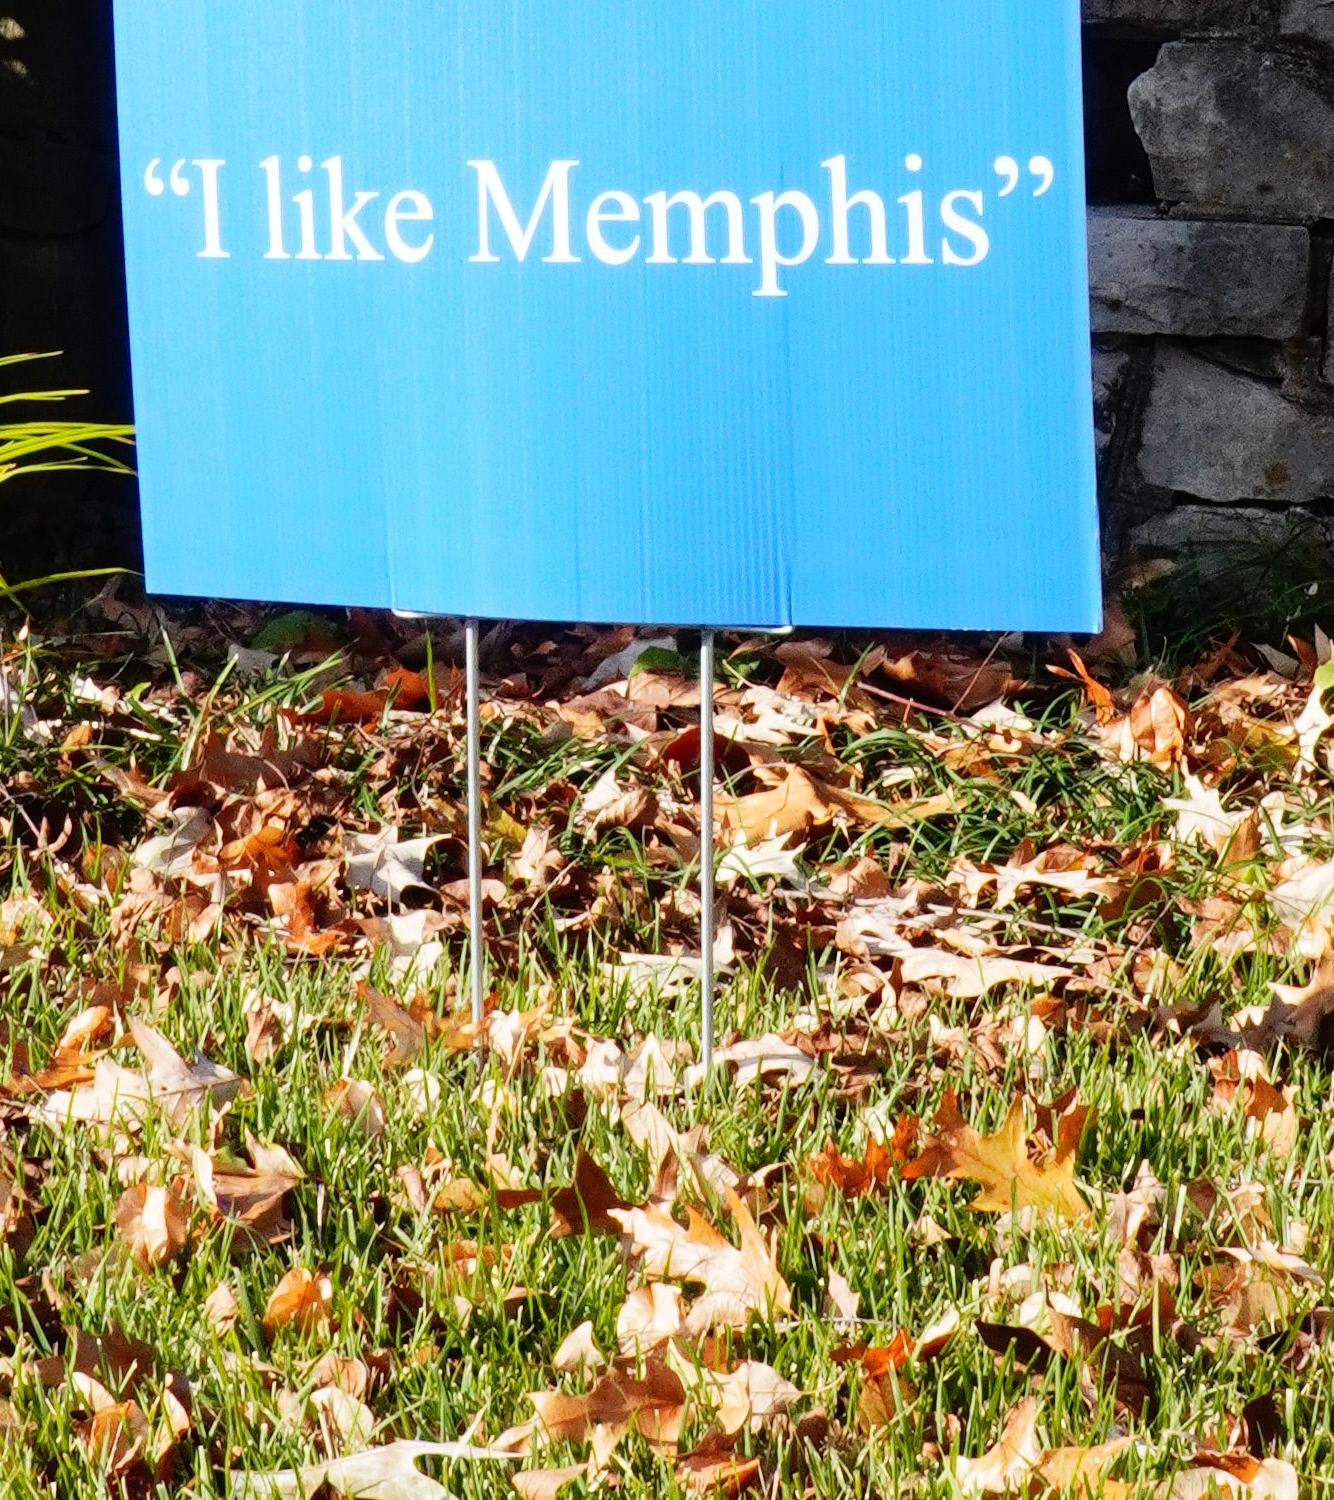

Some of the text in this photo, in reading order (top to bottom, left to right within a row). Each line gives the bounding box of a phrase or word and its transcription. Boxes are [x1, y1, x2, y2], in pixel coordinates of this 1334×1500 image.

[142, 152, 1056, 298] “I like Memphis”
